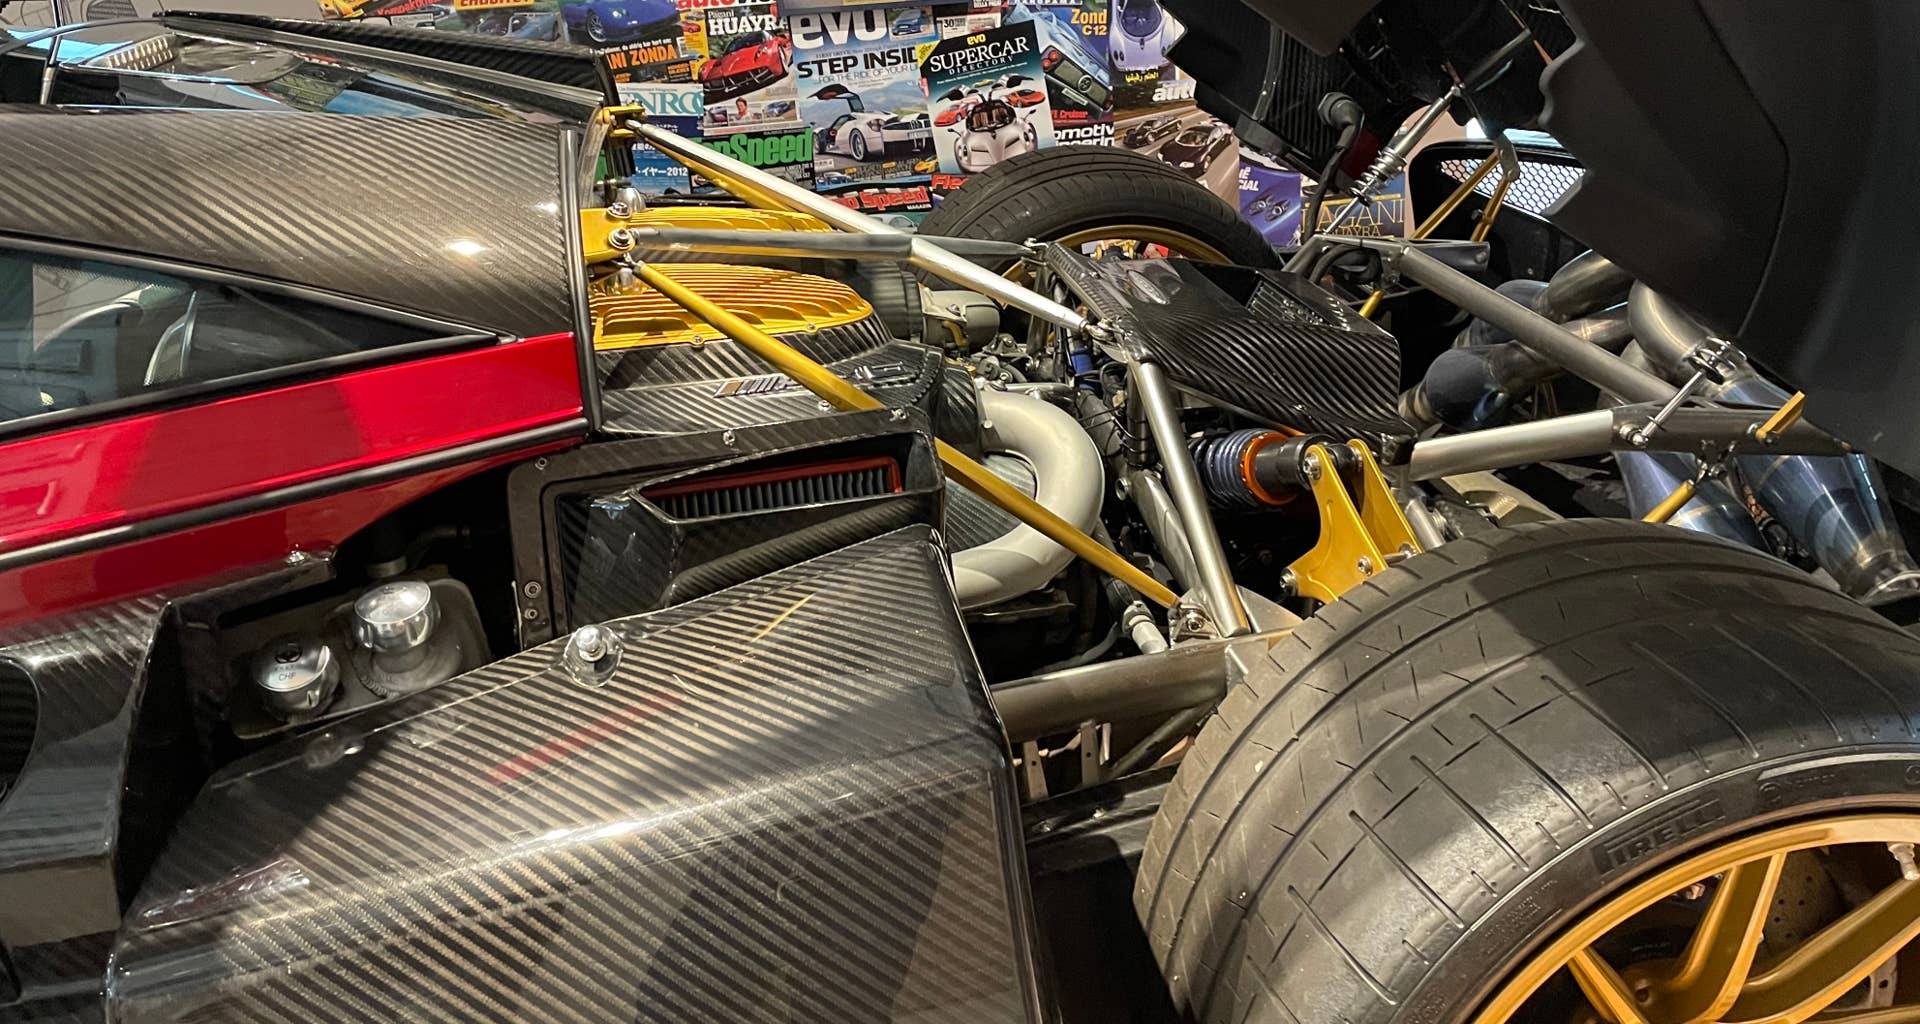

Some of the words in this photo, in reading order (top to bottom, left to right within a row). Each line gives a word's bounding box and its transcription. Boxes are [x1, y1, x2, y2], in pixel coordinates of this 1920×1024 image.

[707, 14, 789, 36] HUAYRA
[943, 18, 955, 28] 30
[1071, 8, 1108, 25] Zond
[790, 9, 889, 49] evo
[966, 33, 987, 46] evo
[1082, 25, 1108, 36] C12
[606, 51, 627, 70] NI
[629, 44, 678, 67] ZONDA
[797, 55, 859, 79] STEP
[863, 46, 918, 70] INSID
[930, 36, 1030, 73] SUPERCAR
[836, 73, 851, 82] THE
[853, 71, 870, 79] RIDE
[872, 69, 882, 77] OF
[883, 64, 909, 75] YOUR
[949, 56, 1014, 76] DIRECTORY
[1053, 123, 1114, 140] omotiv
[860, 186, 930, 211] Speed
[1302, 198, 1404, 233] AGANI
